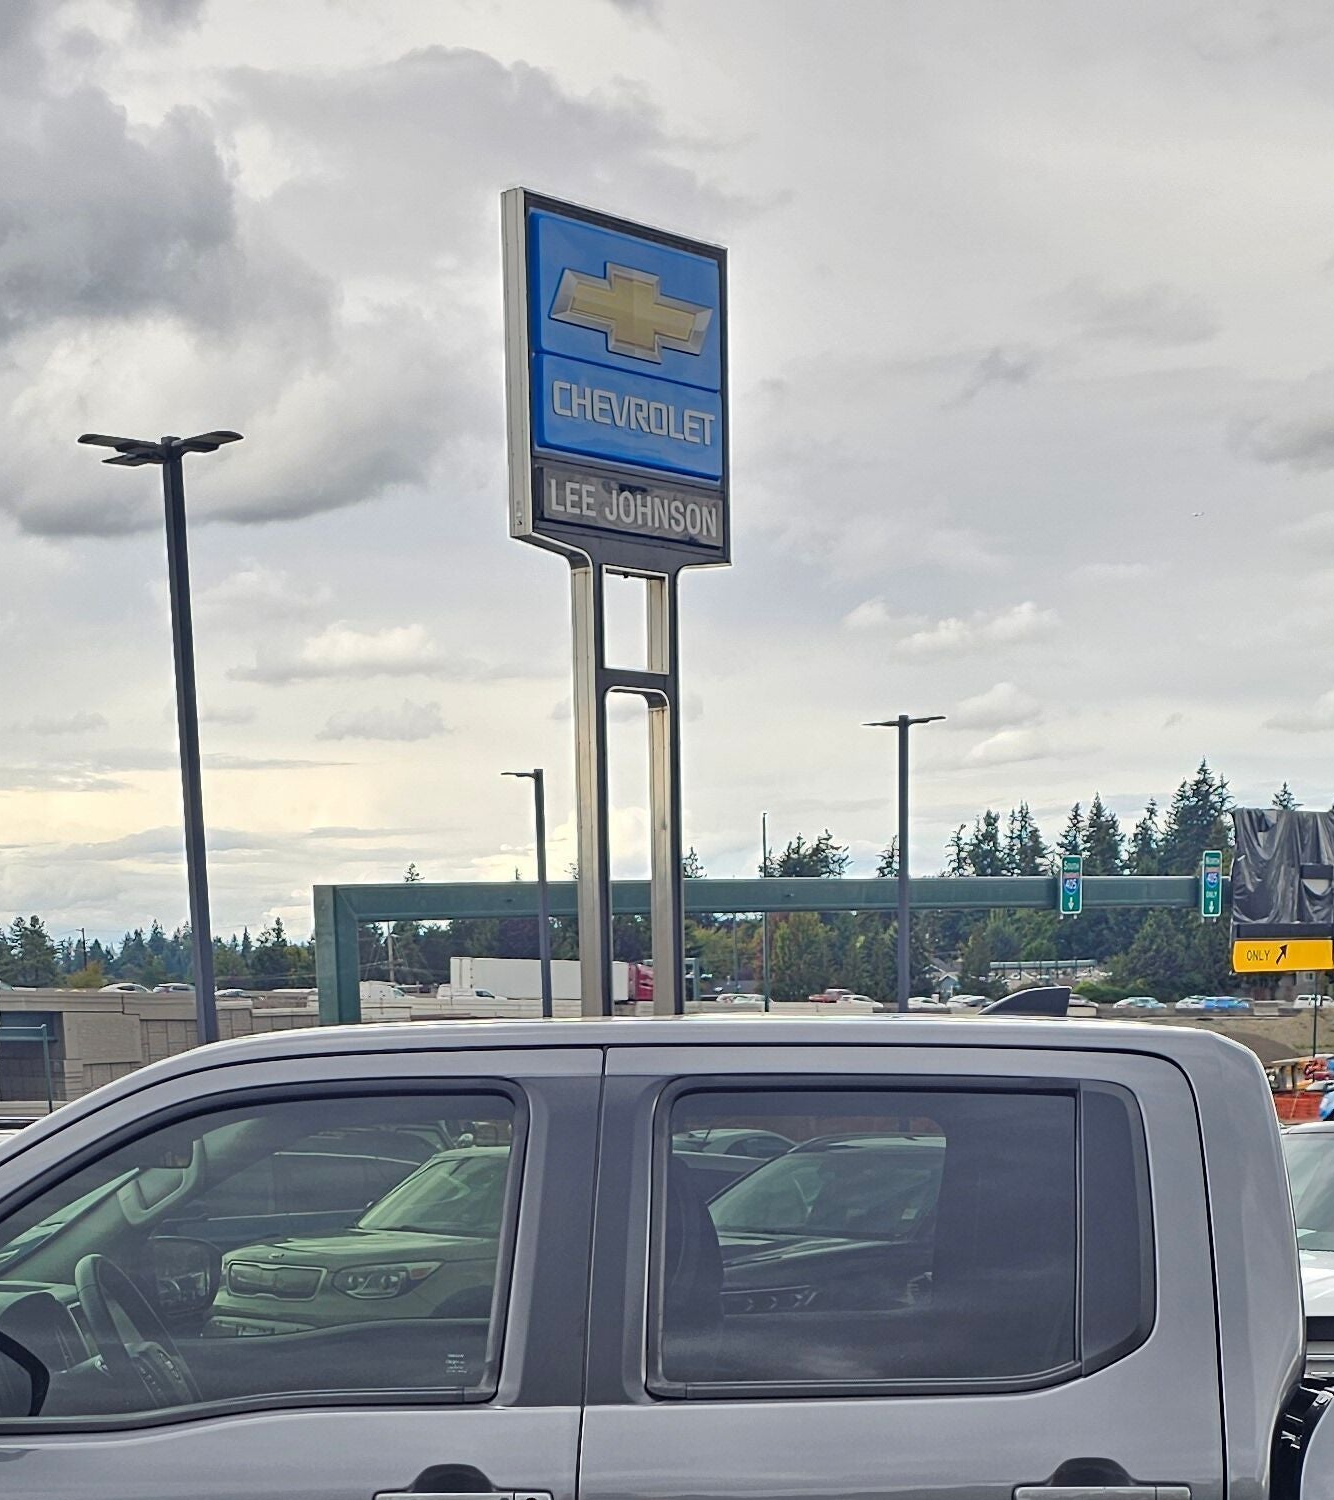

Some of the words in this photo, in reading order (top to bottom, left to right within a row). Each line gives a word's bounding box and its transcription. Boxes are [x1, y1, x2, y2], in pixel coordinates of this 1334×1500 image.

[552, 380, 715, 445] CHEVROLET
[550, 478, 597, 517] LEE
[604, 490, 717, 537] JOHNSON
[1246, 950, 1271, 961] ONLY
